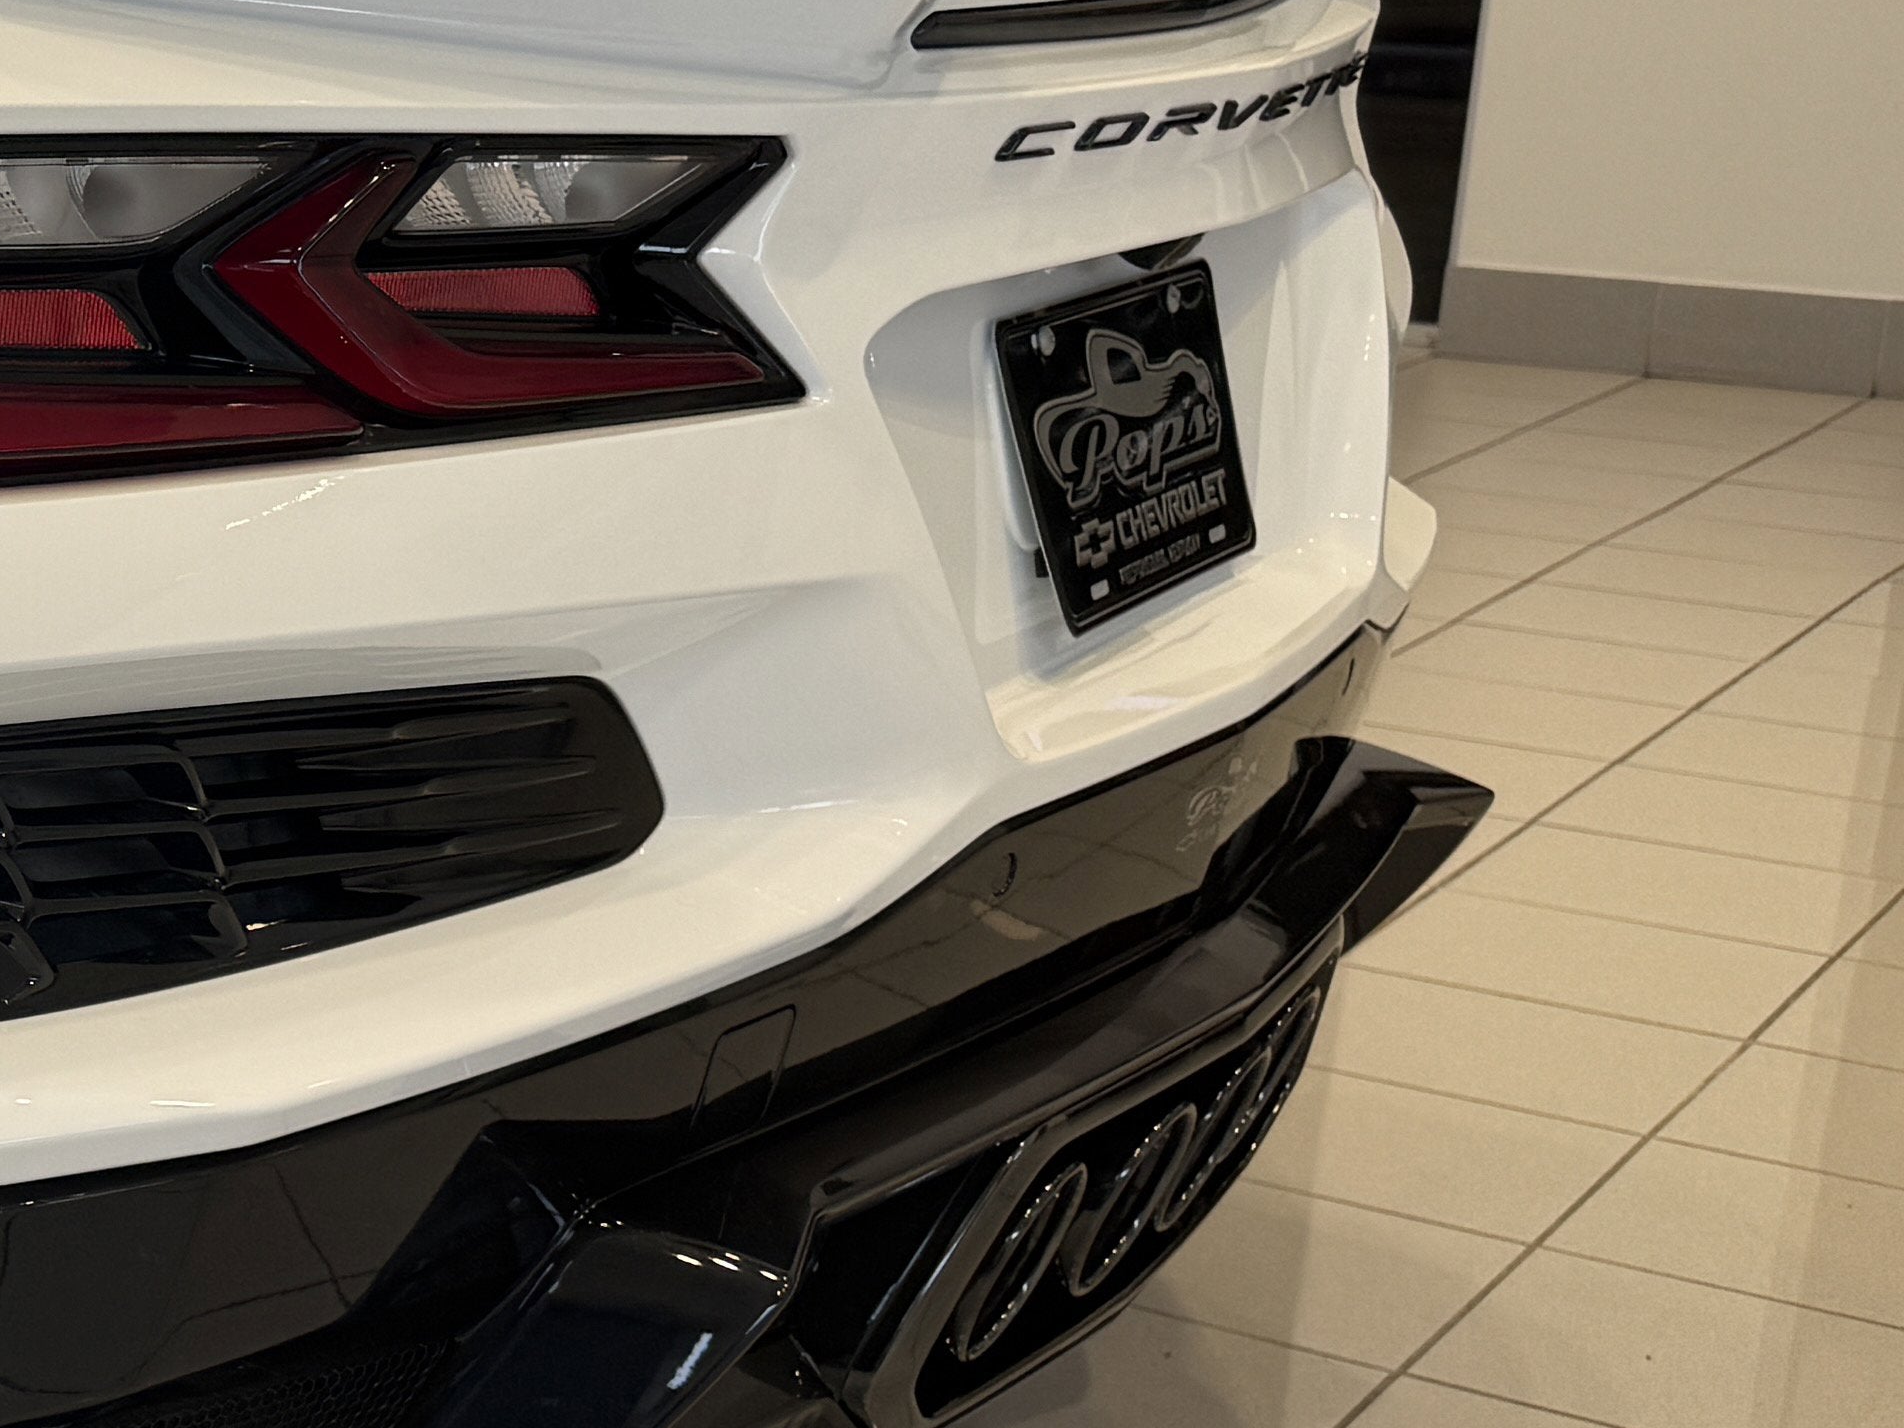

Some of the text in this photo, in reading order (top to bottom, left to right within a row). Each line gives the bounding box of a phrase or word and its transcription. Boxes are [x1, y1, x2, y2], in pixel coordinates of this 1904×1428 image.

[994, 50, 1369, 162] CORVETTE
[1058, 395, 1214, 491] Pop's
[1116, 469, 1228, 551] CHEVROLET
